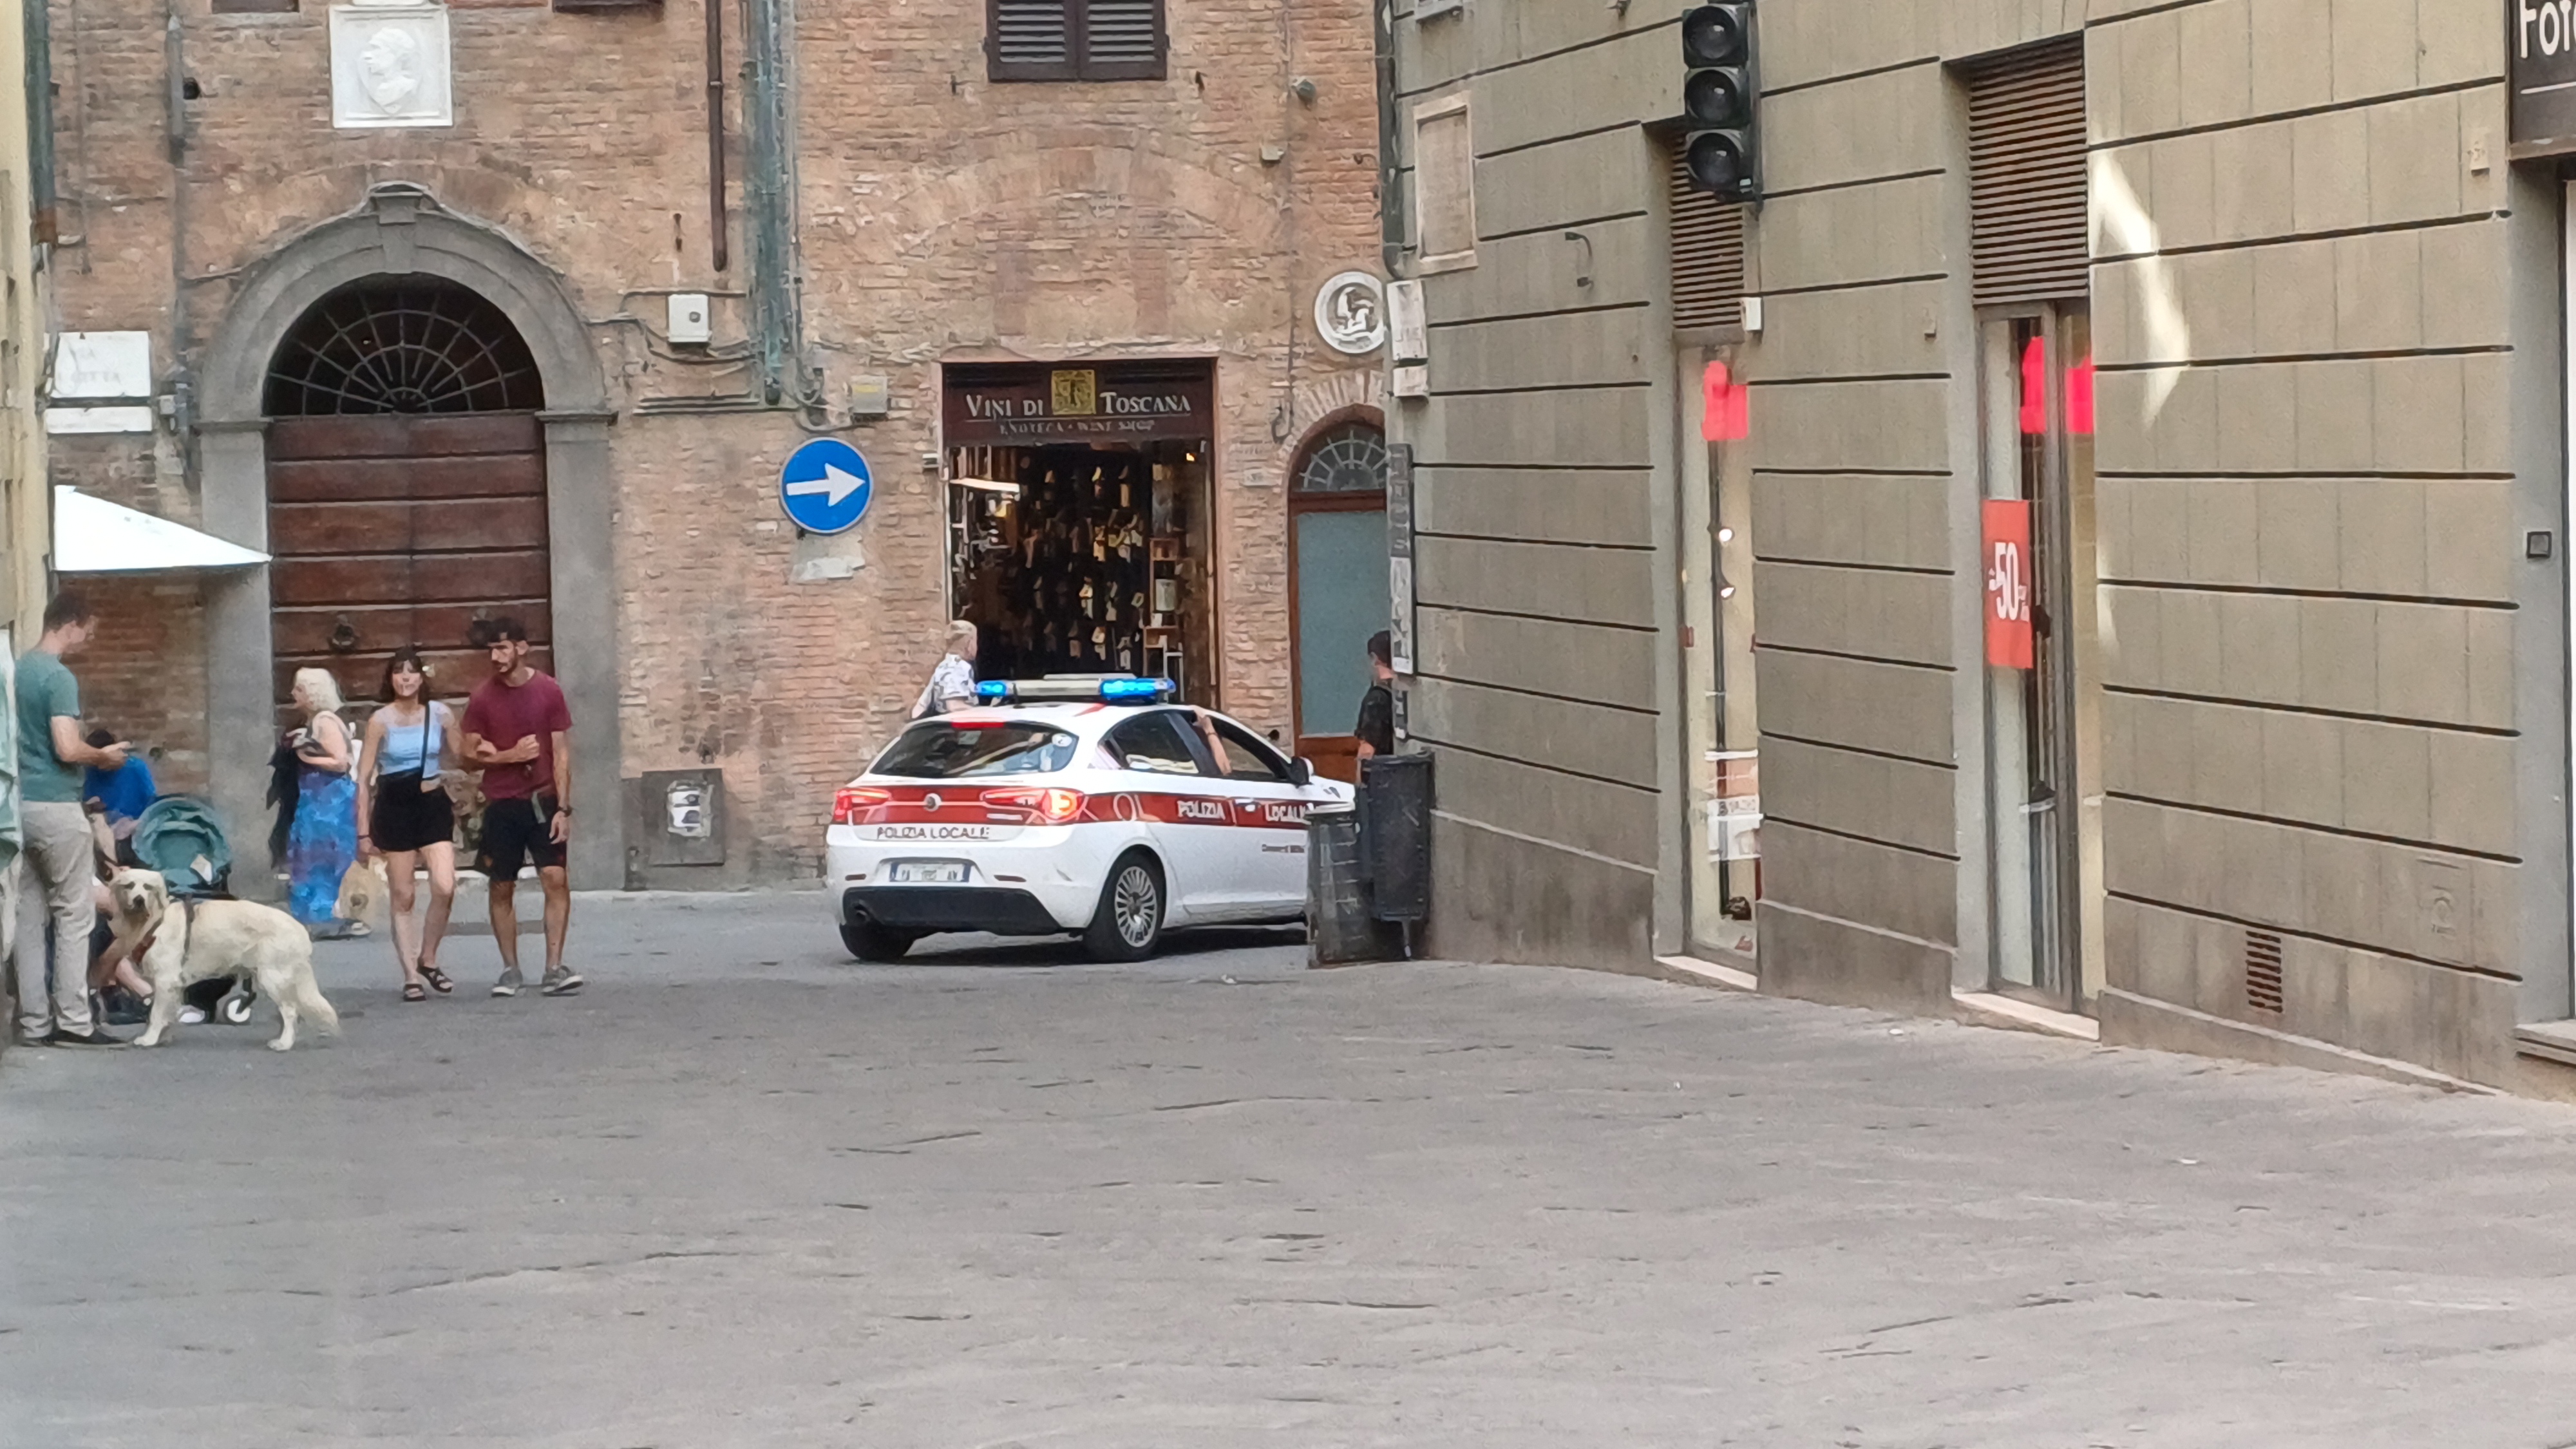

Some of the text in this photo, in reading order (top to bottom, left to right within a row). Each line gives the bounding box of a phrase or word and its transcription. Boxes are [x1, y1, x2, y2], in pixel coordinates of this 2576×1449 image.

[2519, 0, 2576, 59] Fot
[1177, 800, 1226, 820] POLIZIA
[876, 826, 990, 839] POLIZIA LOCALE
